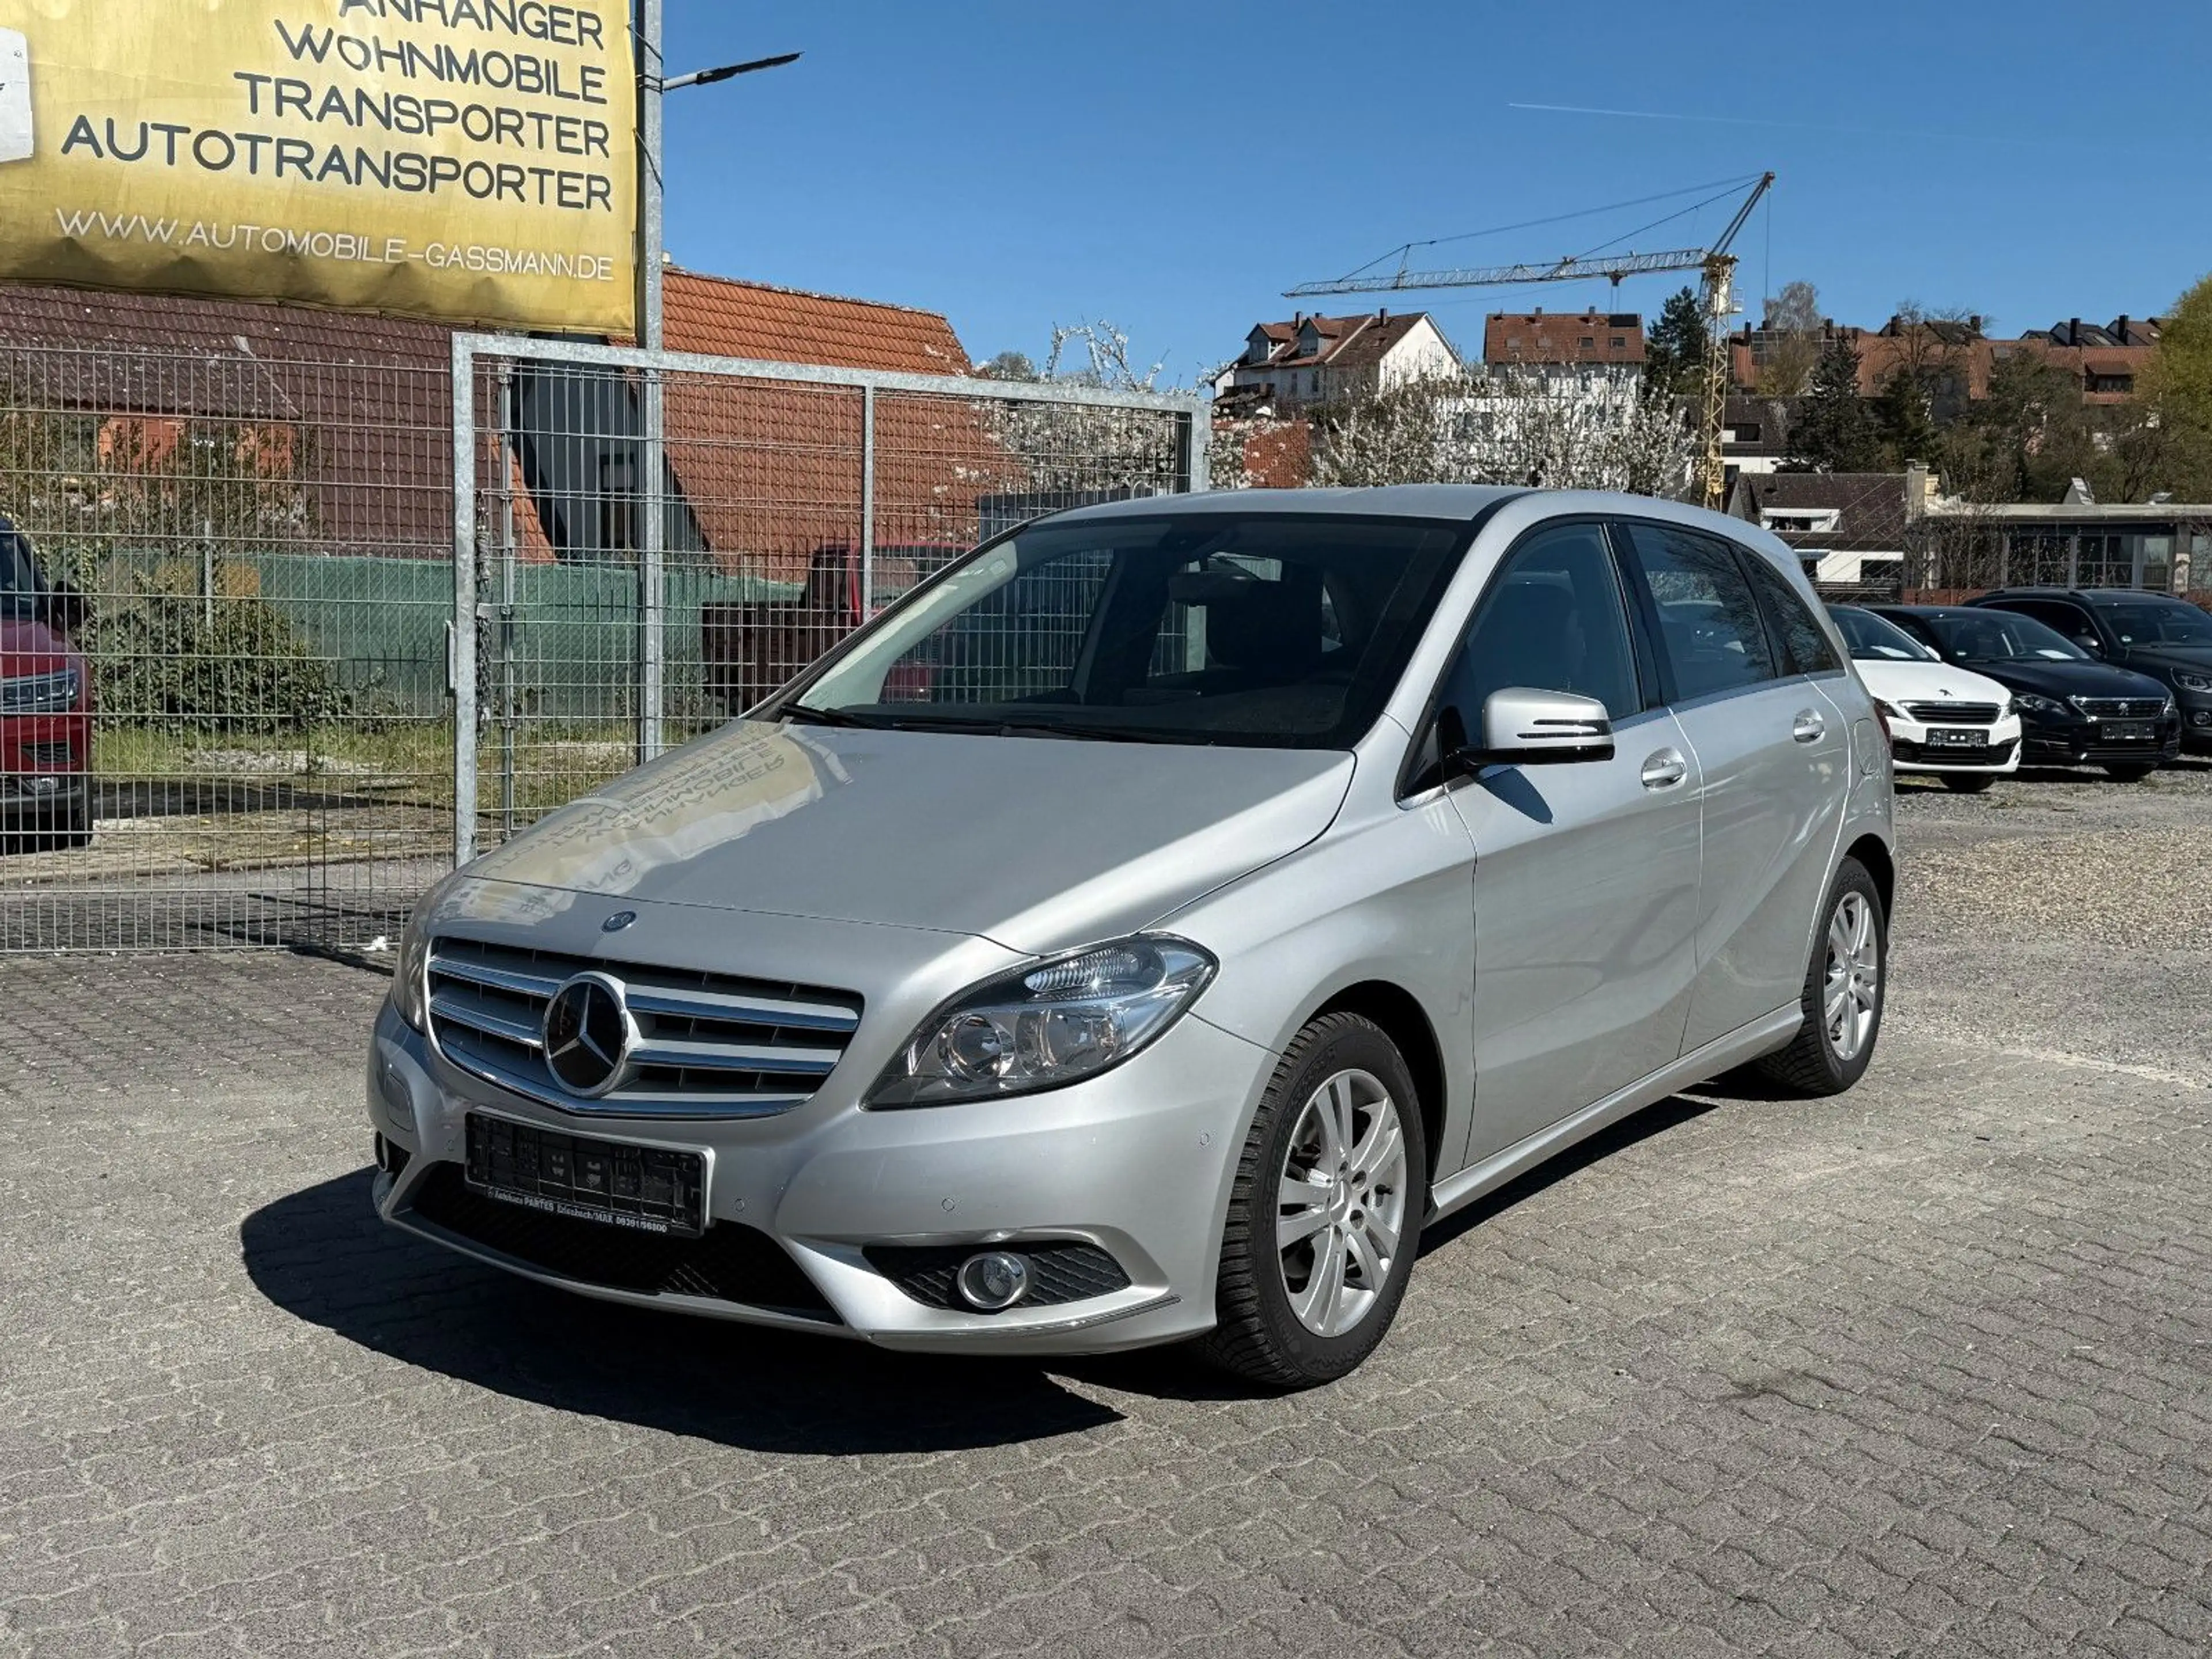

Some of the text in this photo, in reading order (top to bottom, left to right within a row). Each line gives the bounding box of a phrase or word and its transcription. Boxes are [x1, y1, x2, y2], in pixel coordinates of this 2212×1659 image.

[275, 20, 608, 105] WOHNMOBILE
[233, 72, 609, 158] TRANSPORTER
[60, 115, 611, 213] AUTOTRANSPORTER
[56, 207, 615, 281] WWW.AUTOMOBILE-GASSMANN.DE
